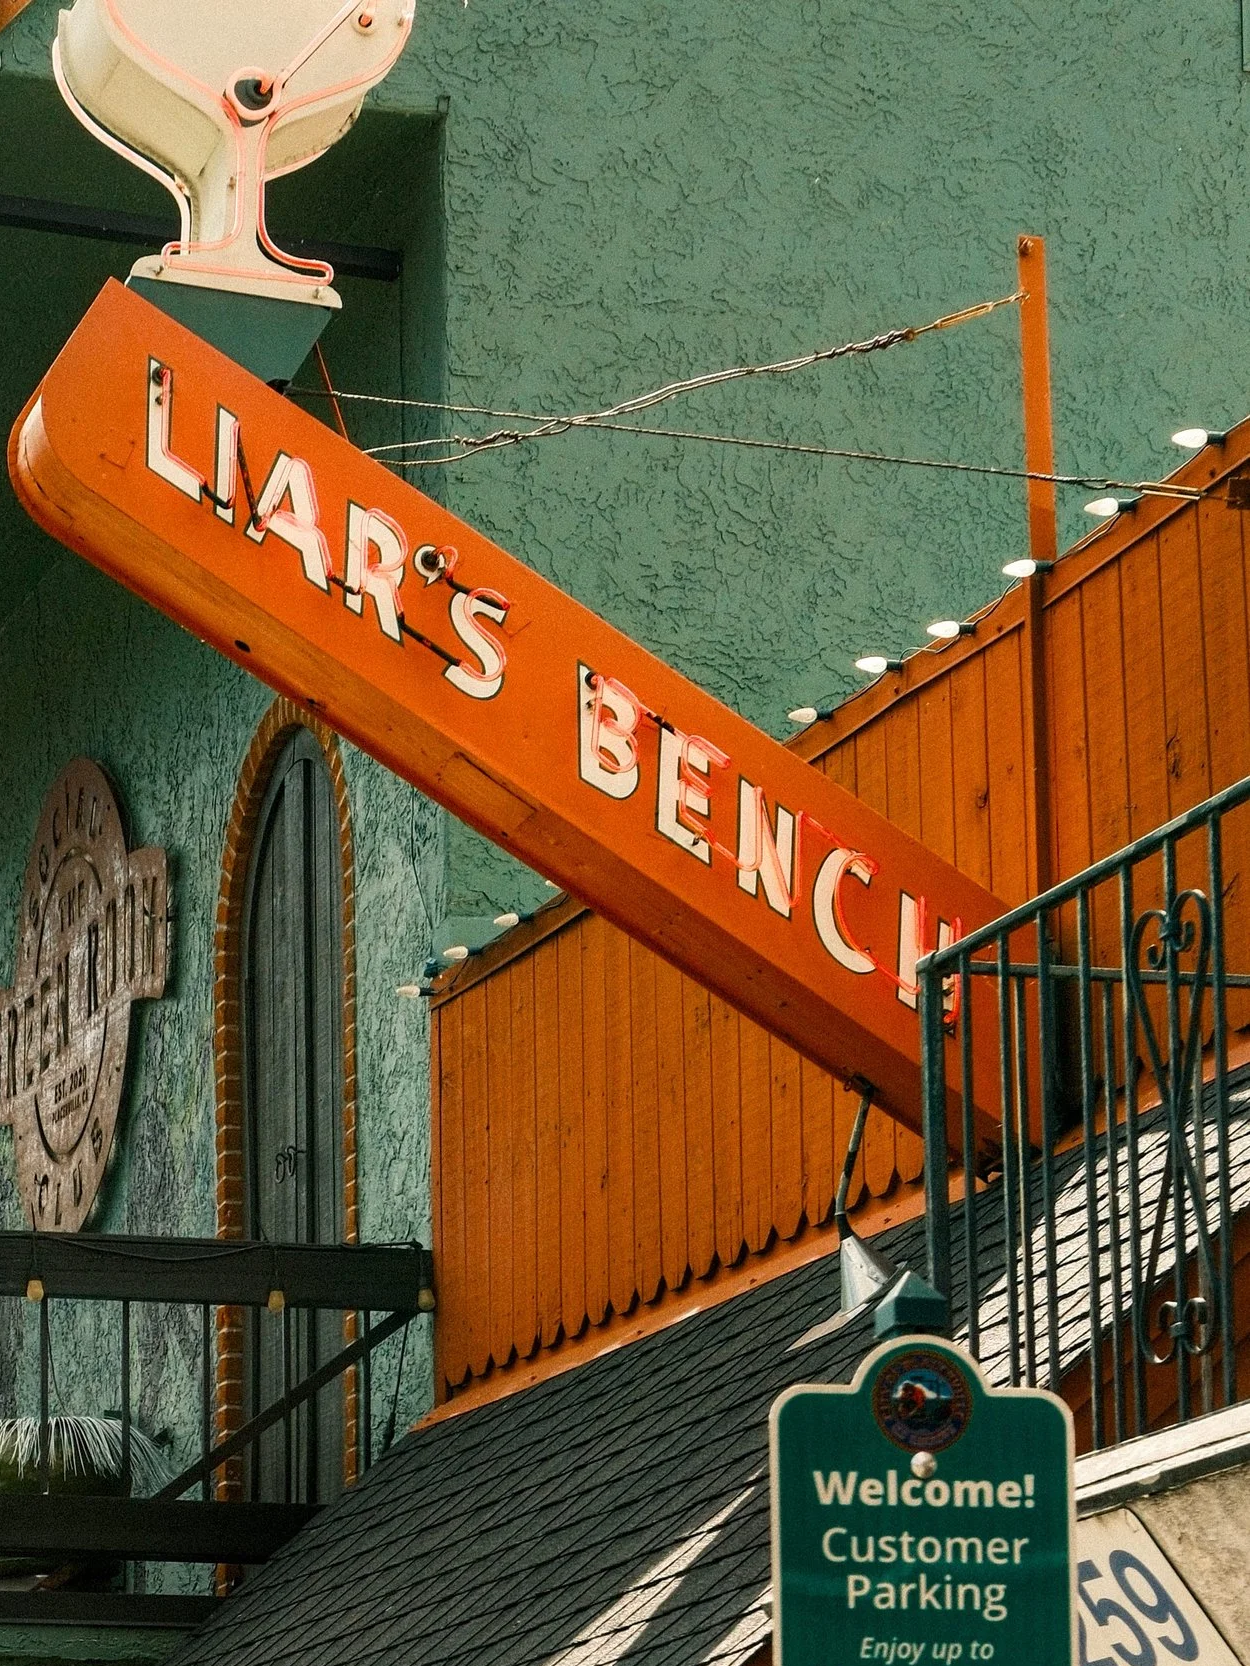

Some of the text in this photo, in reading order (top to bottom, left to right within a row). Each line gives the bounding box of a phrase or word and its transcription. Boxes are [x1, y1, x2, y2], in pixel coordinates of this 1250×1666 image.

[146, 355, 508, 701] LIAR'S
[58, 879, 84, 932] THE
[87, 876, 159, 1019] ROOM
[69, 1064, 87, 1094] 2020
[812, 1469, 1036, 1508] Welcome!
[821, 1527, 1029, 1564] Customer
[846, 1573, 1008, 1622] Parking
[859, 1636, 995, 1666] Enjoy up to
